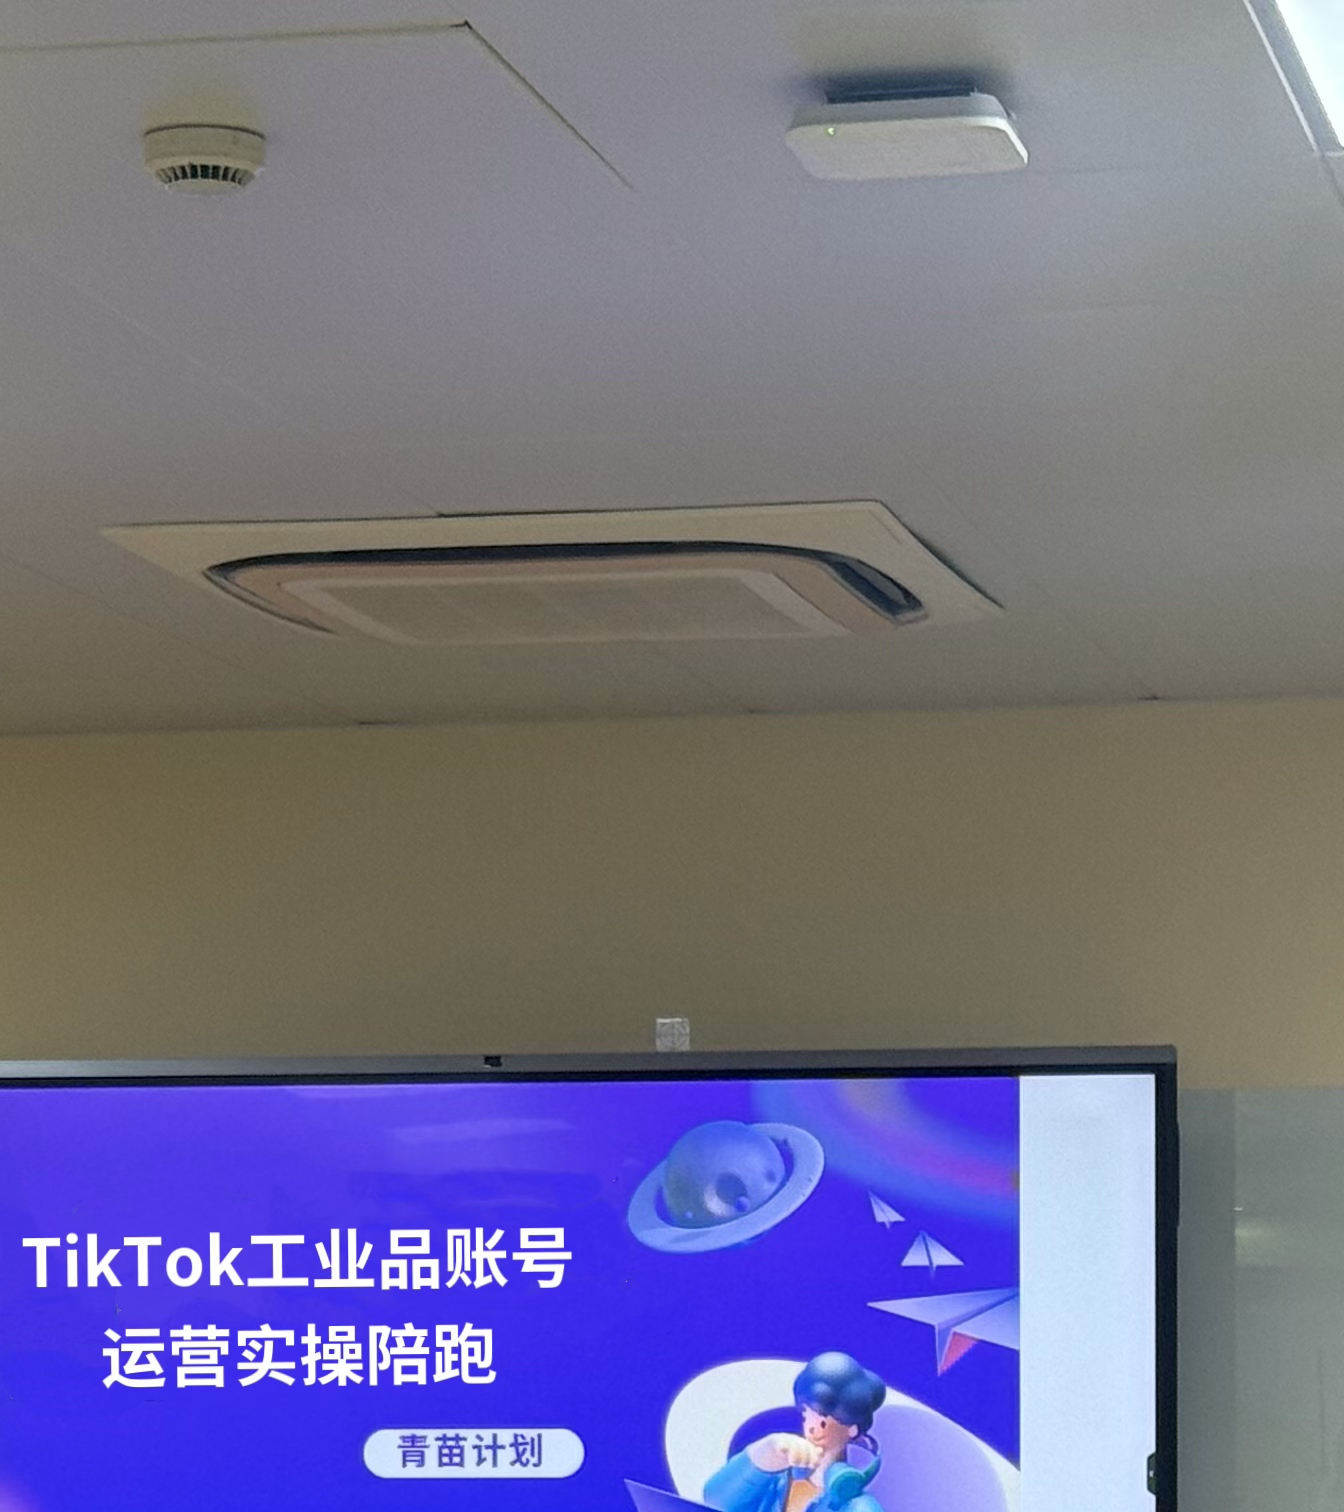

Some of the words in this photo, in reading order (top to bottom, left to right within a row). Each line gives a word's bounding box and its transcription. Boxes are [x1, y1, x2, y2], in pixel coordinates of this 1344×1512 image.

[22, 1226, 574, 1291] TikTok工业品账号
[101, 1321, 498, 1390] 运营实操陪跑
[397, 1432, 544, 1469] 青苗计划
